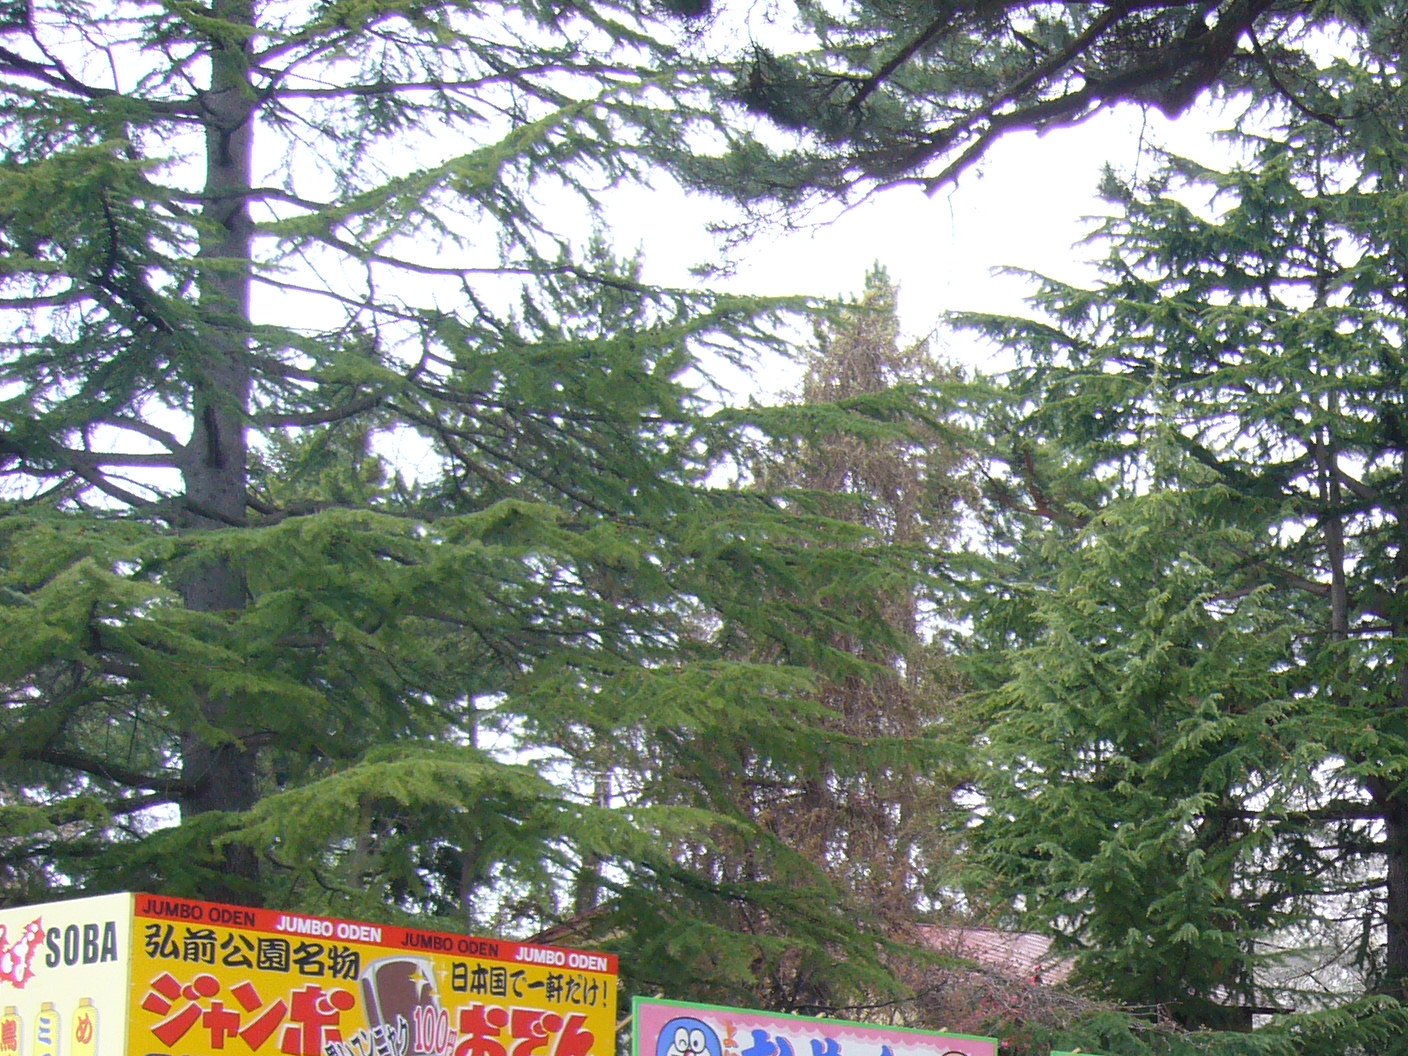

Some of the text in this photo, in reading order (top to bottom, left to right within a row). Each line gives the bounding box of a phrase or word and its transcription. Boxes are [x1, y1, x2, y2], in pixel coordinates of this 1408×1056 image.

[45, 921, 118, 968] SOBA
[142, 899, 608, 971] JUMBO ODEN JUMBO ODEN JUMBO ODEN JUMBO ODEN
[144, 923, 361, 981] 弘前公園名物
